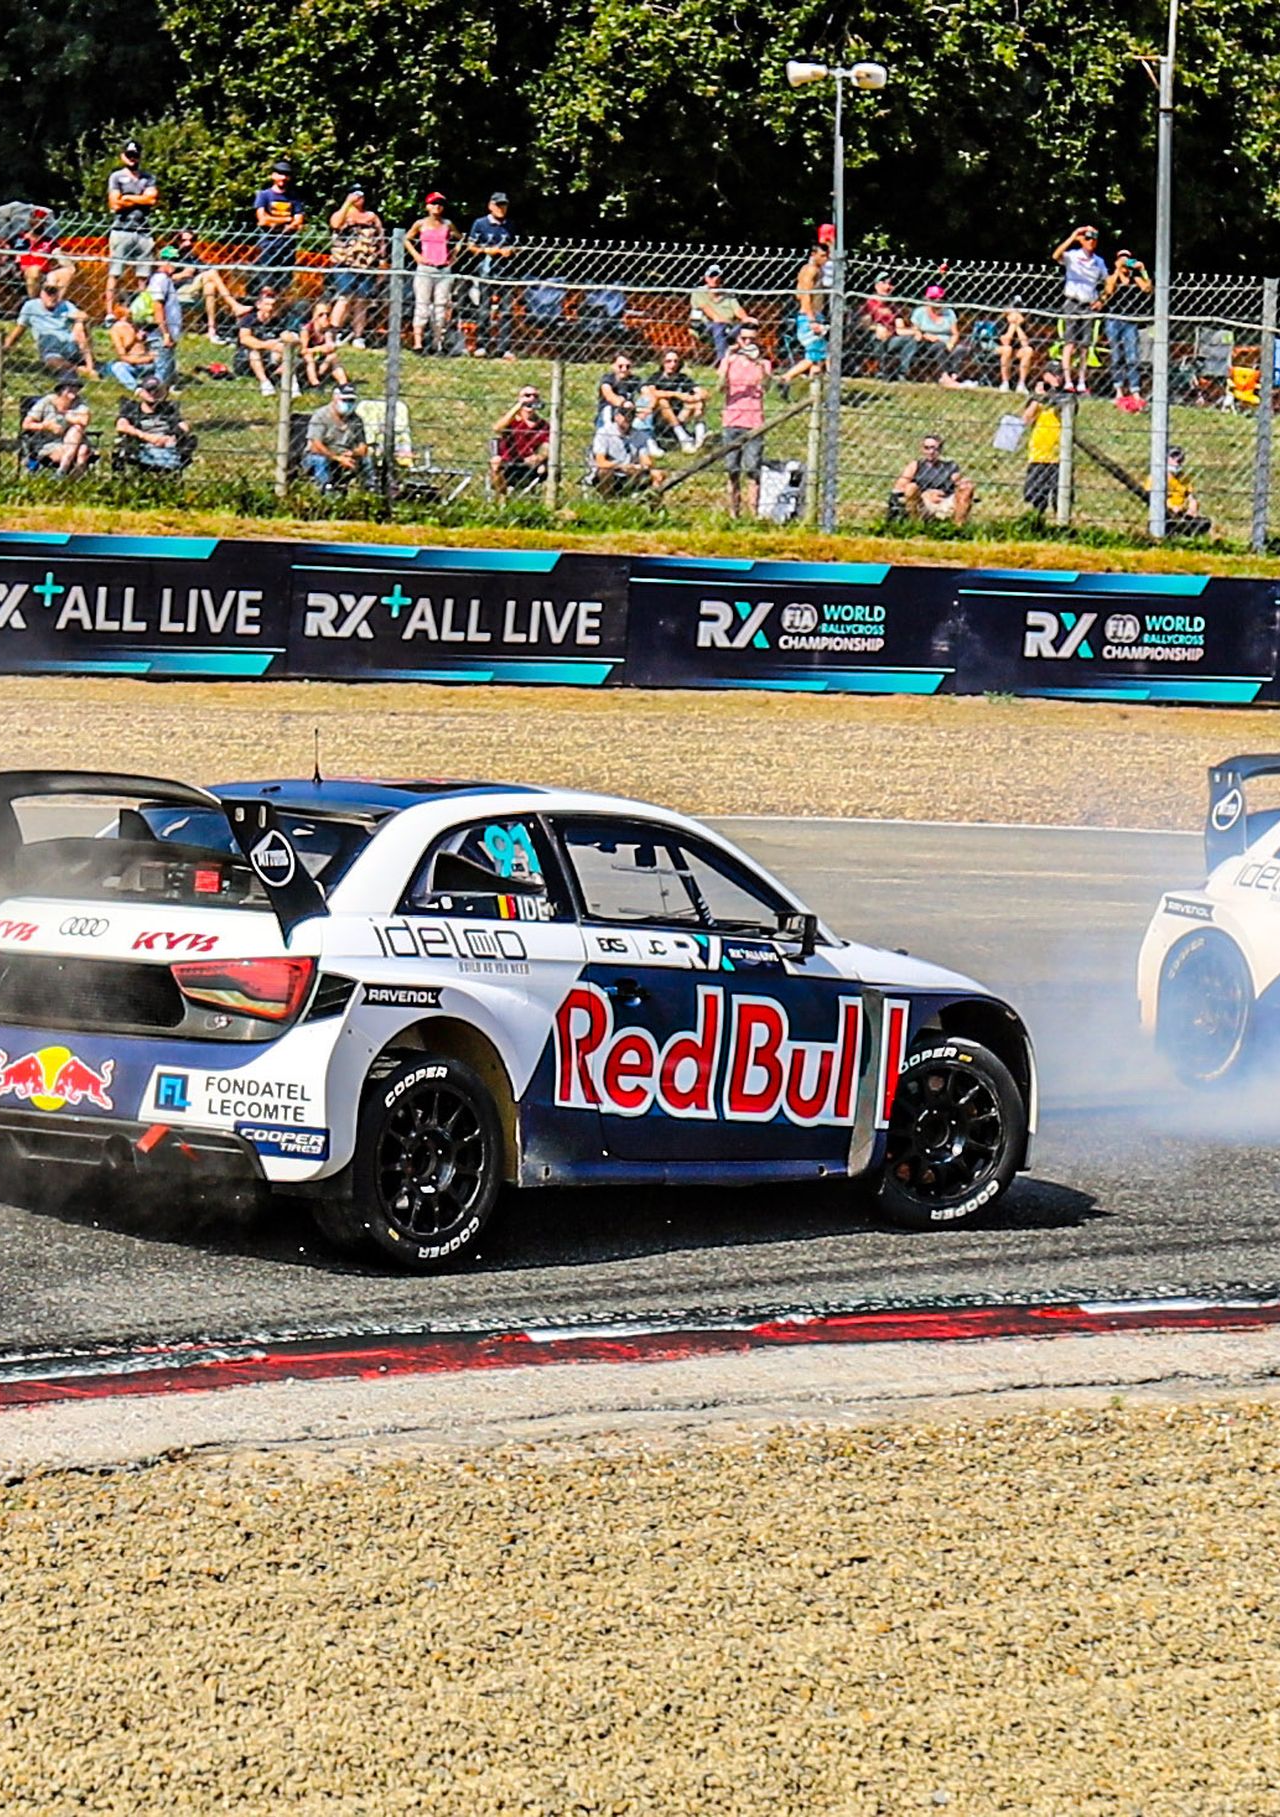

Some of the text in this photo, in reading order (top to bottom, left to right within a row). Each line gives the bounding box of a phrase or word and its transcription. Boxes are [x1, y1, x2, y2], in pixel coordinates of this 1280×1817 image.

[159, 587, 263, 637] LIVE
[502, 598, 604, 647] LIVE
[823, 604, 887, 624] WORLD
[1145, 615, 1205, 634] WORLD
[696, 600, 775, 650] RX
[820, 622, 886, 636] RALLYCROSS
[1024, 611, 1098, 659] RX
[778, 635, 886, 653] CHAMPIONSHIP
[1143, 632, 1205, 646] RALLYCROSS
[1101, 644, 1205, 663] CHAMPIONSHIP
[484, 823, 542, 878] 91
[516, 897, 550, 921] IDE
[131, 931, 220, 953] KYB
[555, 982, 910, 1129] Red Bull
[898, 1046, 959, 1075] OOPER
[205, 1076, 312, 1102] FONDATEL
[385, 1066, 449, 1108] COOPER
[207, 1099, 306, 1123] LECOMTE
[240, 1128, 326, 1147] COOPER
[280, 1142, 322, 1154] TIRES
[931, 1179, 1000, 1221] COOPER
[417, 1215, 480, 1259] COOPER
